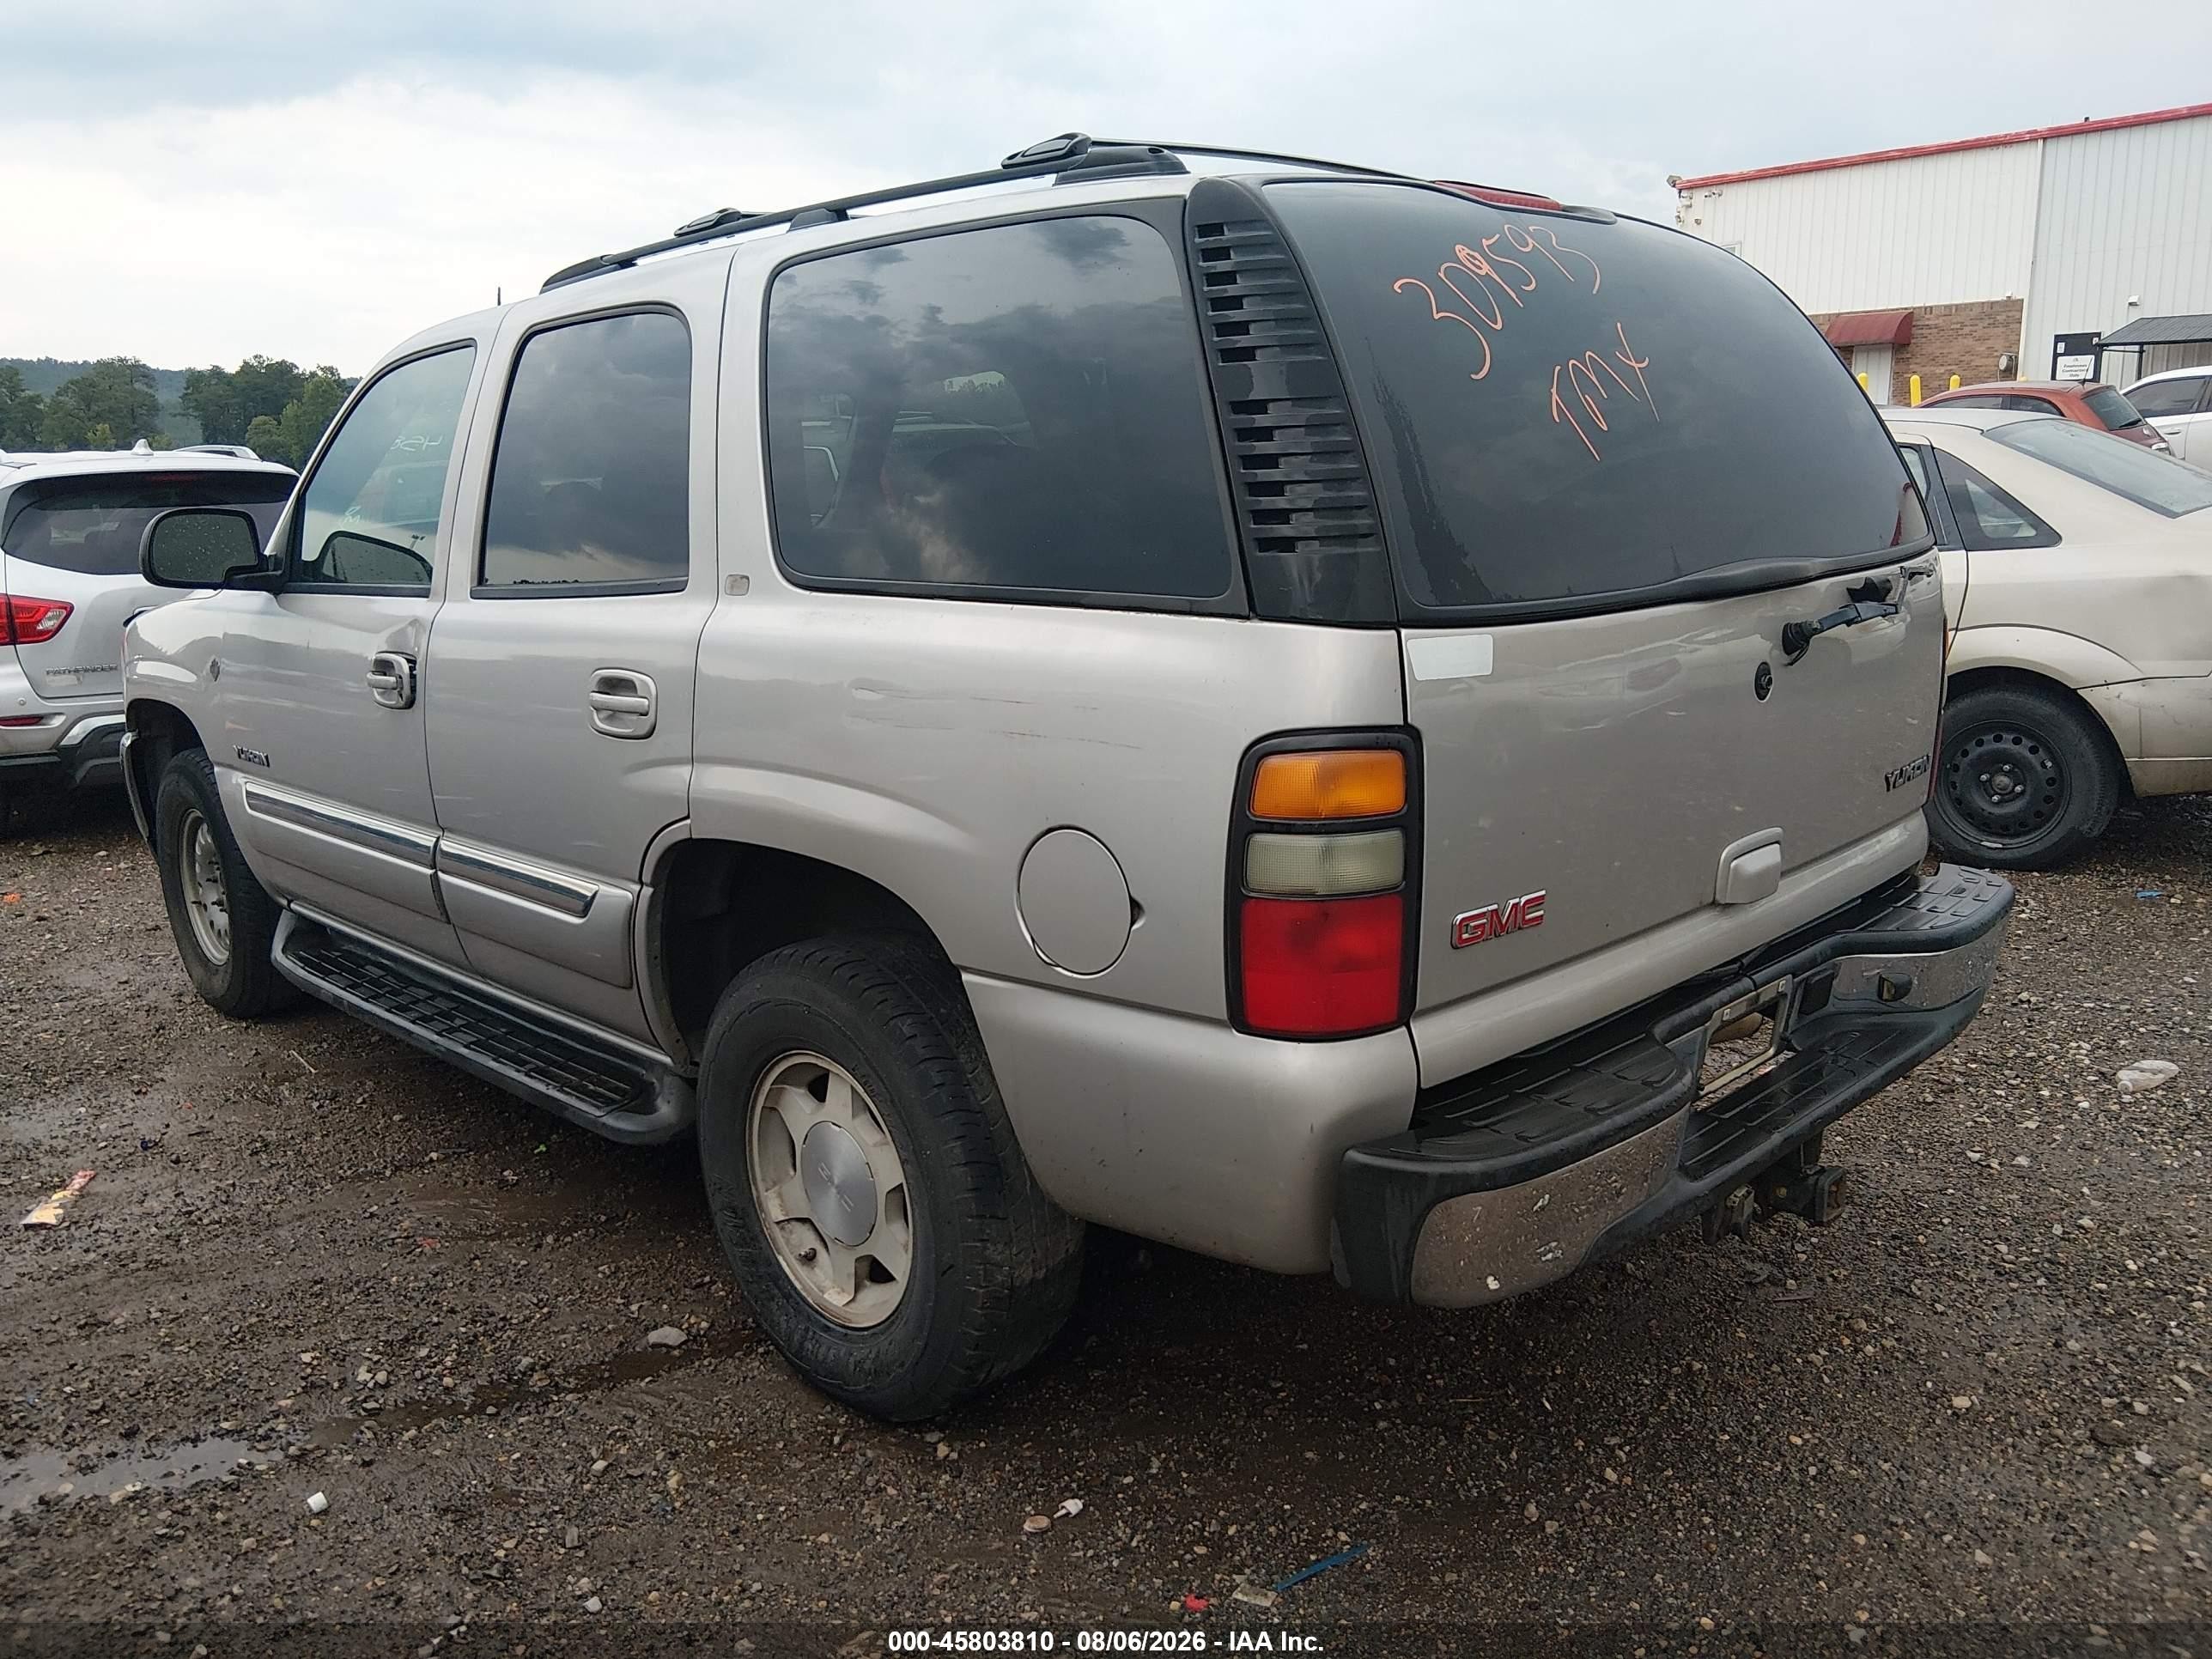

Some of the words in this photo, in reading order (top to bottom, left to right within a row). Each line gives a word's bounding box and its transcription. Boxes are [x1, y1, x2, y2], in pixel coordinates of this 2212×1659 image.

[1392, 223, 1601, 381] 309593
[46, 664, 118, 676] PATHFINDER
[233, 744, 270, 769] YUKON
[1884, 753, 1931, 793] YUKON
[1450, 889, 1547, 950] GMC
